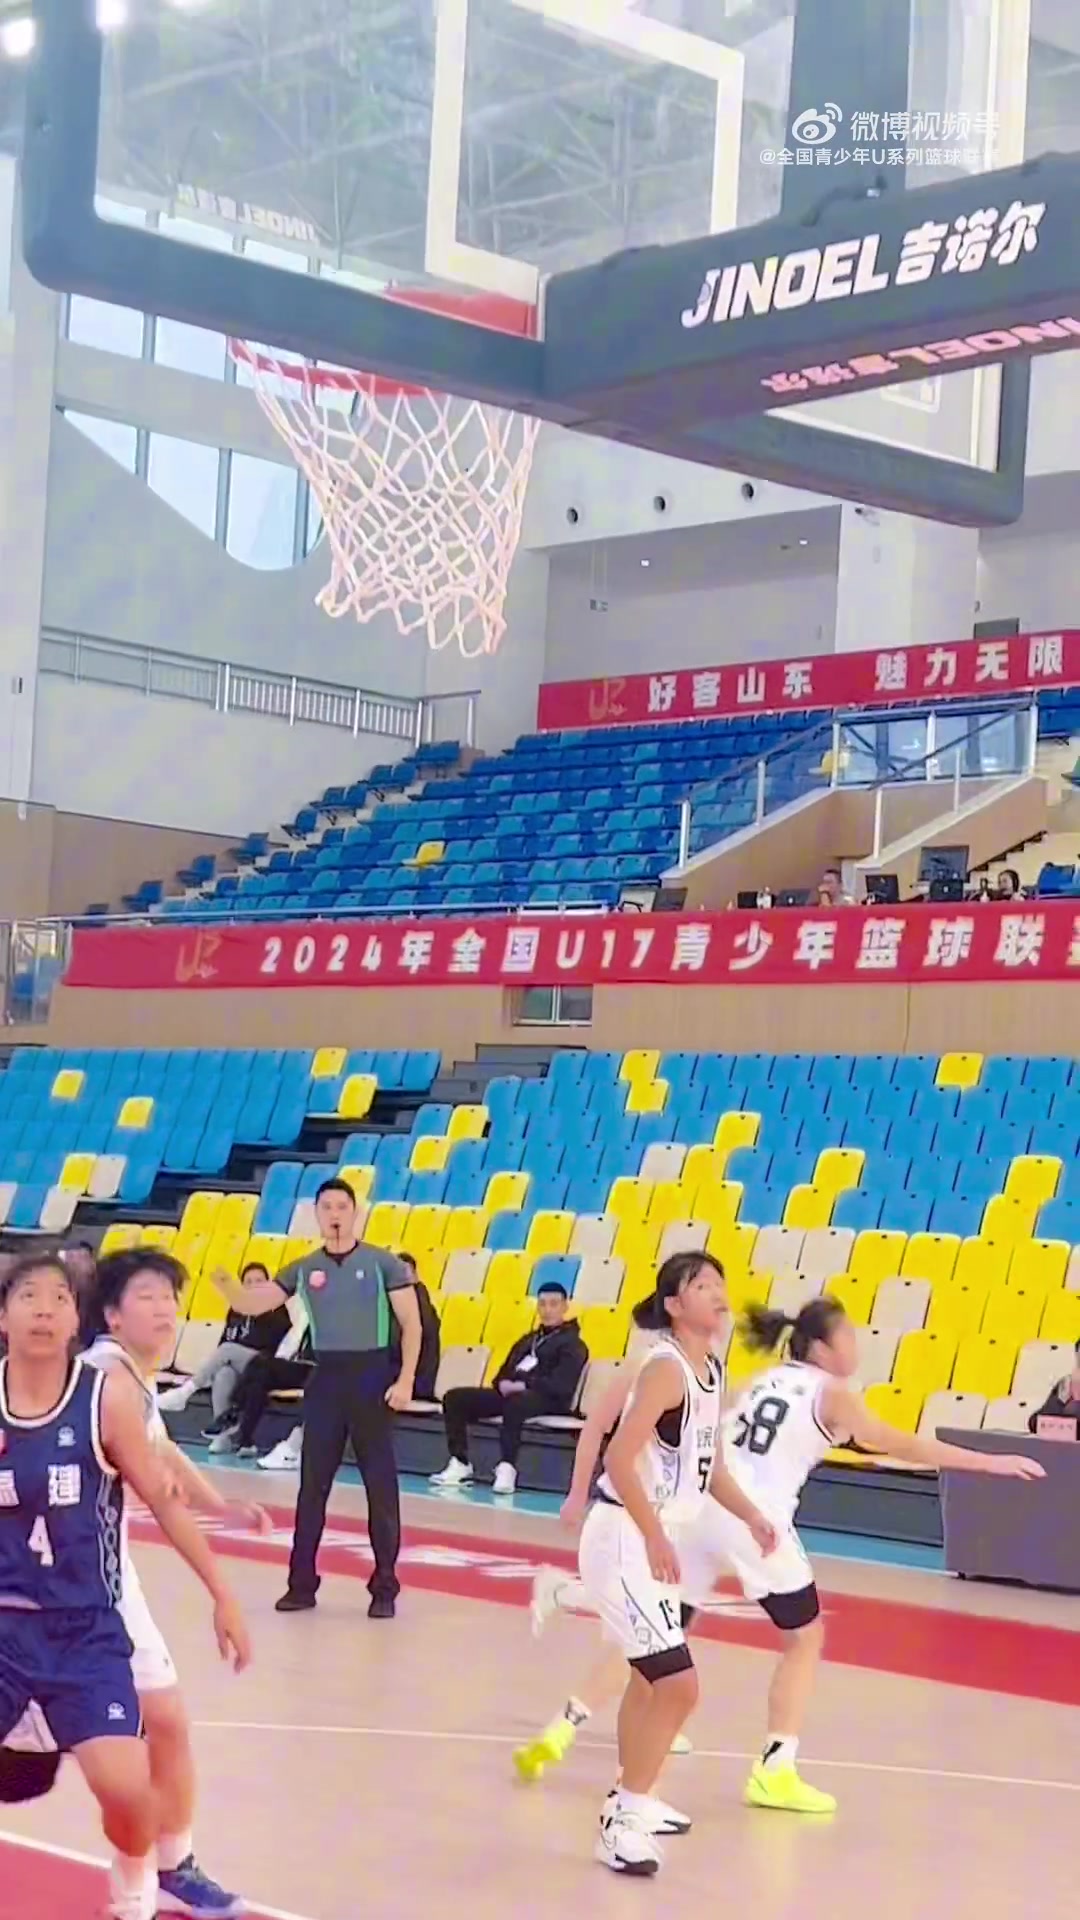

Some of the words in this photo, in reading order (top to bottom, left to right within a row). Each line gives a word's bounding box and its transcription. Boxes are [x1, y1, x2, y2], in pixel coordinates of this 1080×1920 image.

[680, 233, 890, 328] JINOEL
[895, 201, 1046, 286] 吉诺尔
[647, 662, 813, 713] 好客山东
[874, 635, 1064, 692] 魅力无限
[27, 1514, 54, 1568] 4
